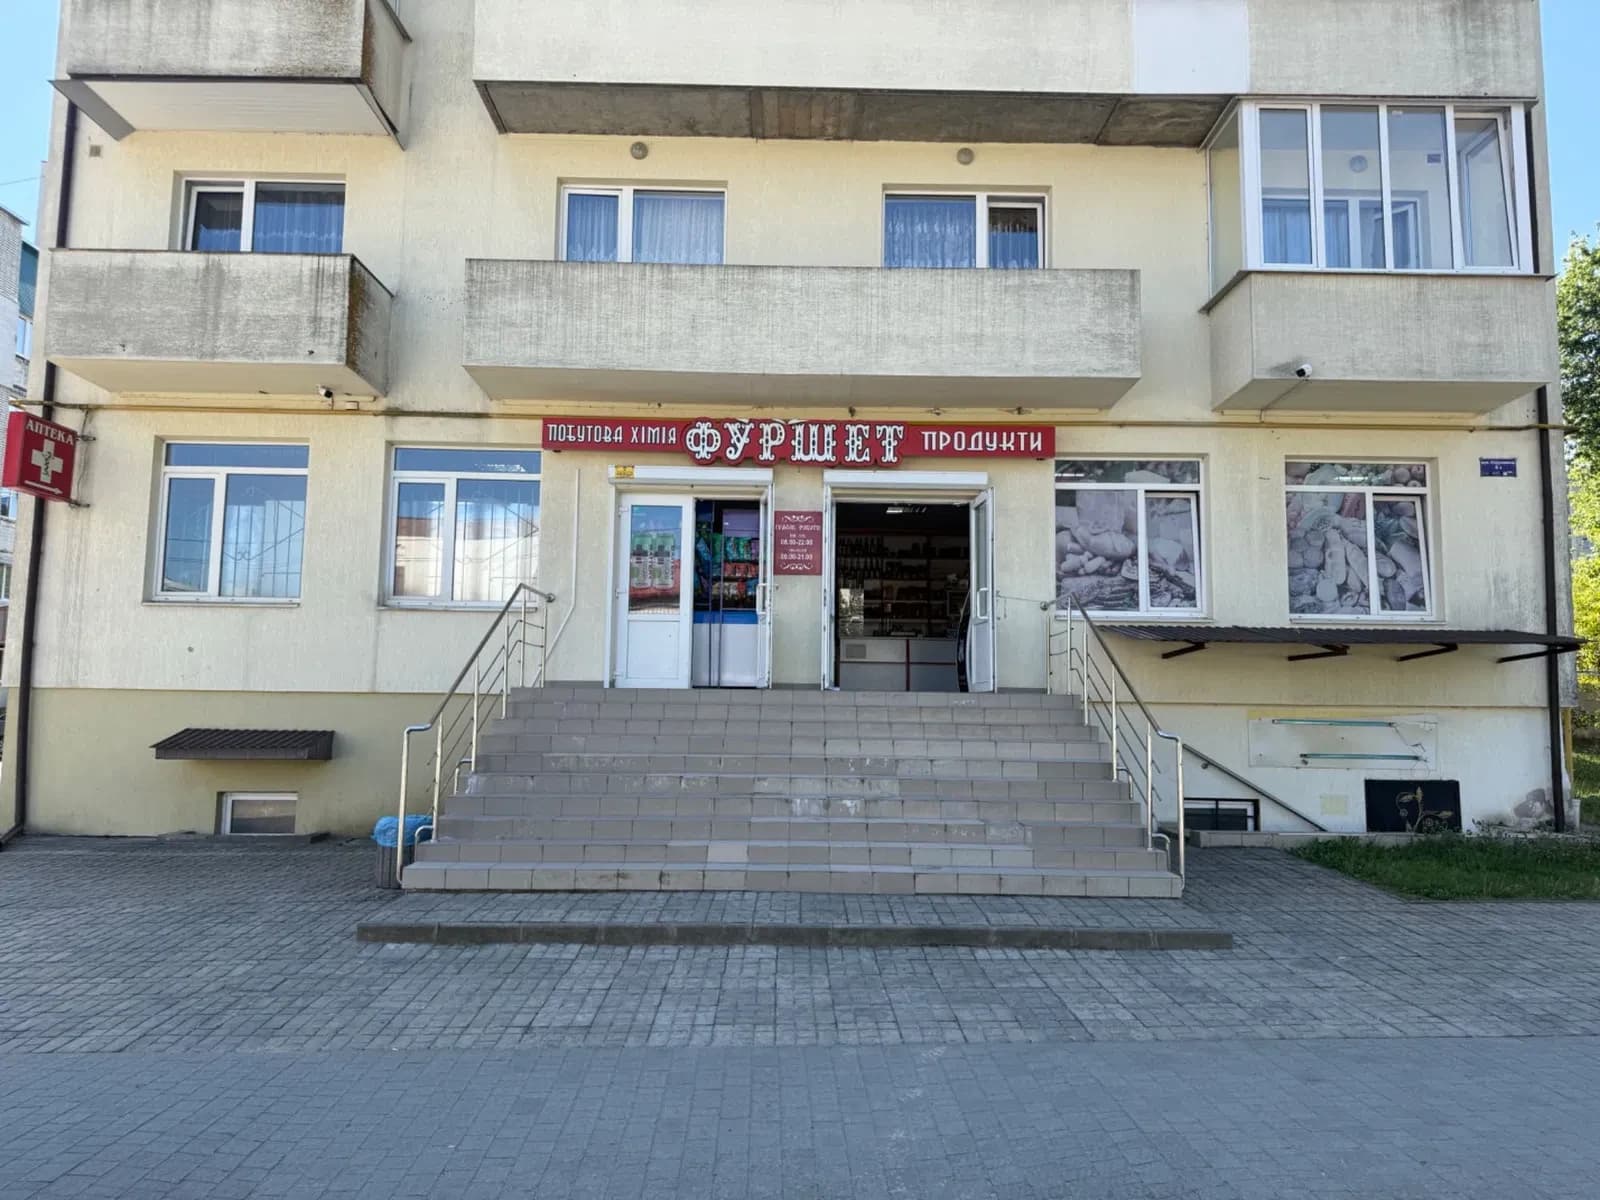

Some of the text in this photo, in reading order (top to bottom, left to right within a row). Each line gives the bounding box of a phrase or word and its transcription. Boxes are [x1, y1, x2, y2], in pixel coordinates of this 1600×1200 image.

[26, 419, 74, 445] АПТЕКА
[547, 420, 1042, 463] ПОБУТОВА ХІМІЯ ФУРШЕТ ПРОДУКТИ
